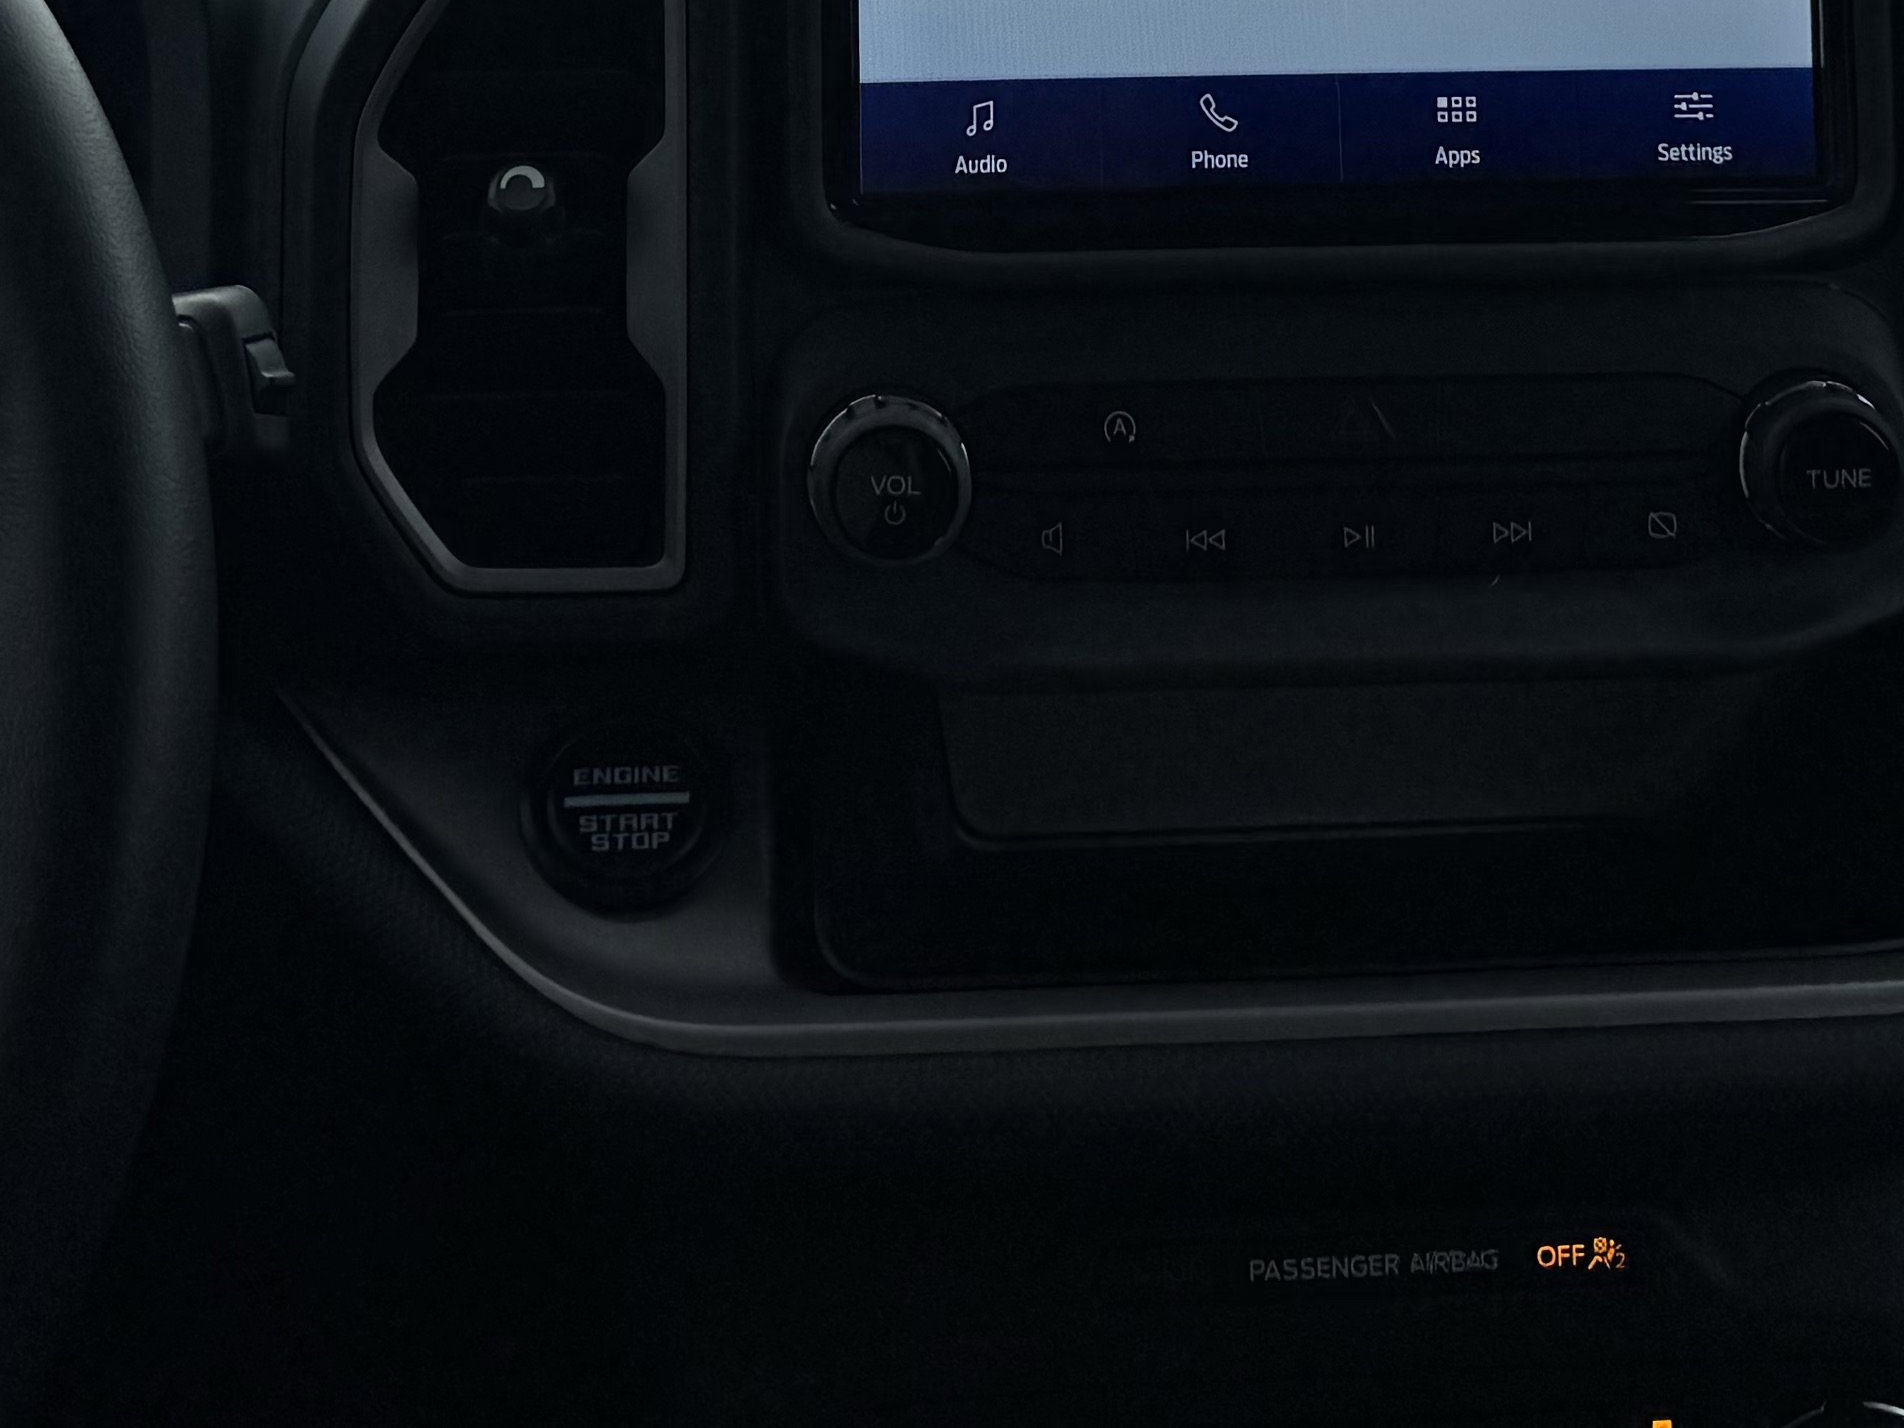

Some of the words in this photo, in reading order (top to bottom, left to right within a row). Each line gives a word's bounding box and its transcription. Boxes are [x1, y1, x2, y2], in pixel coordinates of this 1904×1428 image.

[954, 154, 1008, 174] Audio
[1190, 149, 1249, 170] Phone
[1434, 145, 1481, 170] Apps
[1656, 142, 1733, 168] Settings
[869, 474, 921, 498] VOL
[1806, 465, 1873, 491] TUNE
[572, 764, 682, 786] ENGINE
[578, 812, 679, 833] START
[591, 831, 671, 853] STOP
[1248, 1253, 1400, 1283] PASSENGER
[1410, 1248, 1500, 1275] AIRBAG
[1536, 1242, 1586, 1270] OFF
